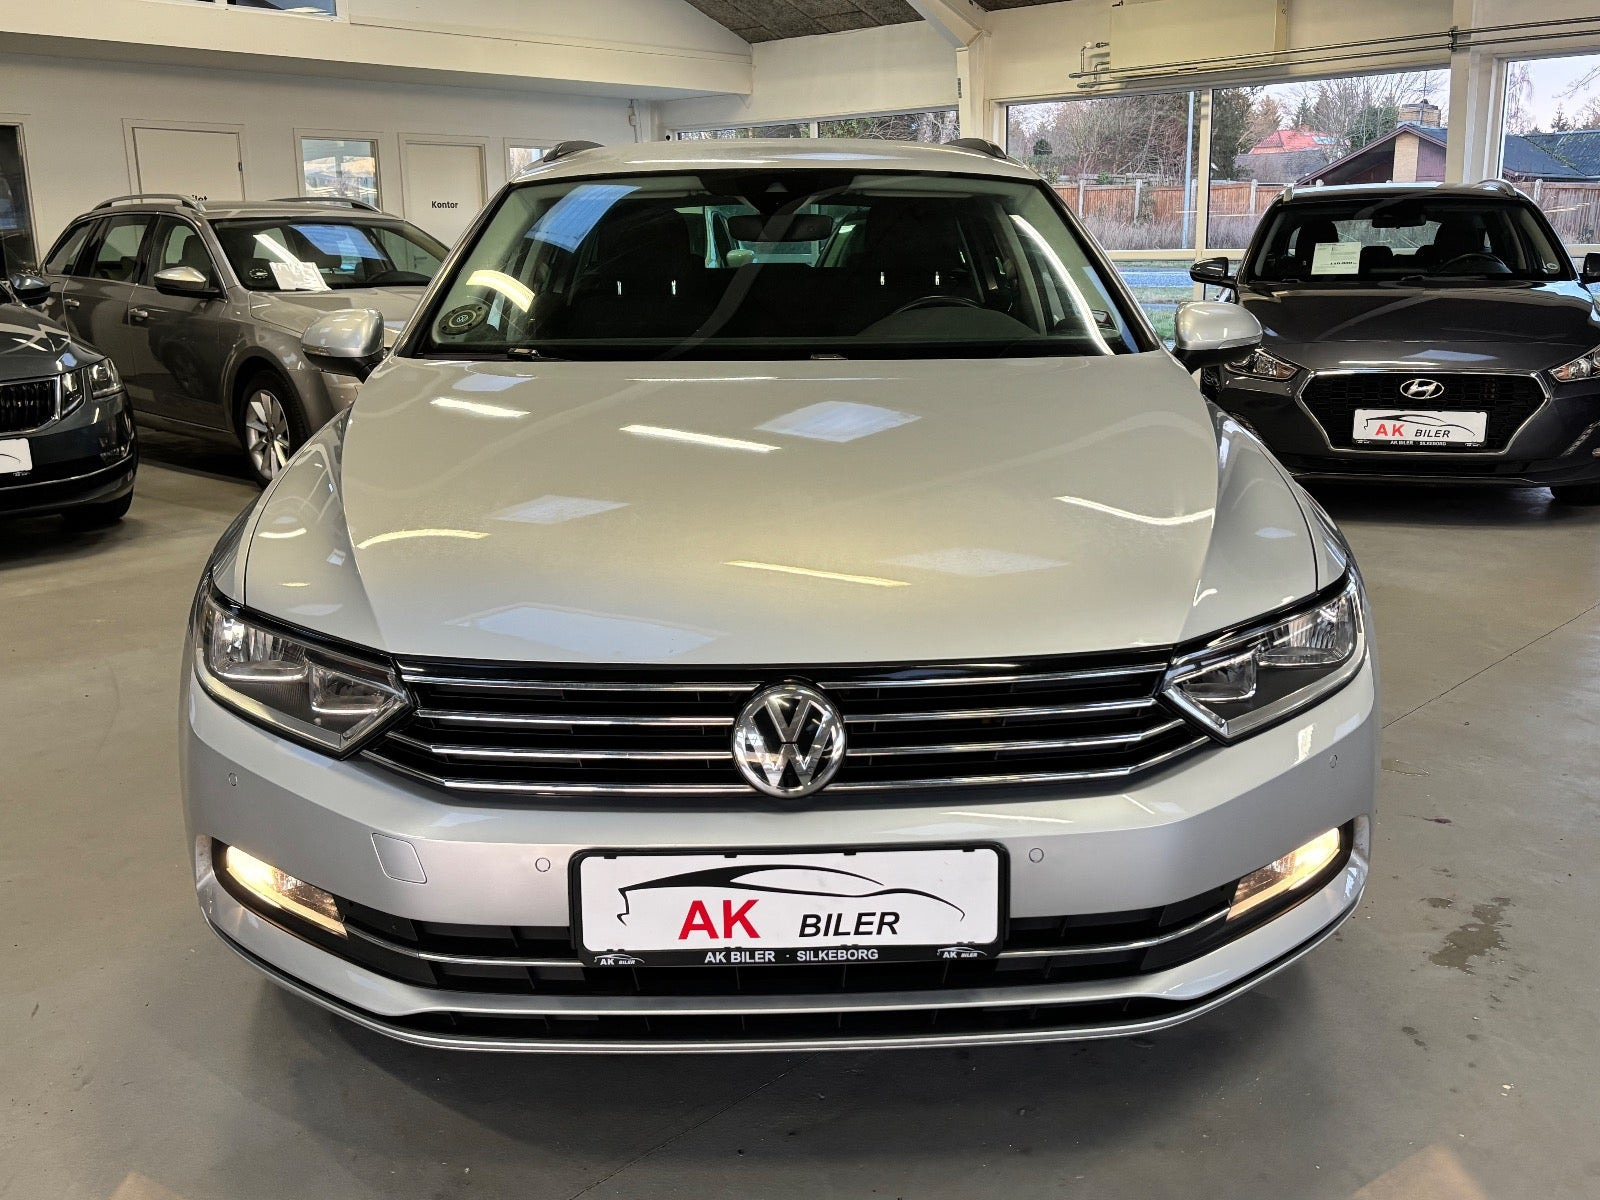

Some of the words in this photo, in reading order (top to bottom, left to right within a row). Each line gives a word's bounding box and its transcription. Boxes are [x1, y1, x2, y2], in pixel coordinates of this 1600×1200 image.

[431, 200, 459, 209] Kontor
[1375, 424, 1405, 437] AK
[1414, 429, 1451, 438] BILER
[678, 899, 761, 940] AK
[798, 911, 900, 938] BILER
[600, 958, 615, 966] AK
[704, 951, 727, 964] AK
[730, 950, 775, 963] BILER
[796, 949, 879, 962] SILKEBORG
